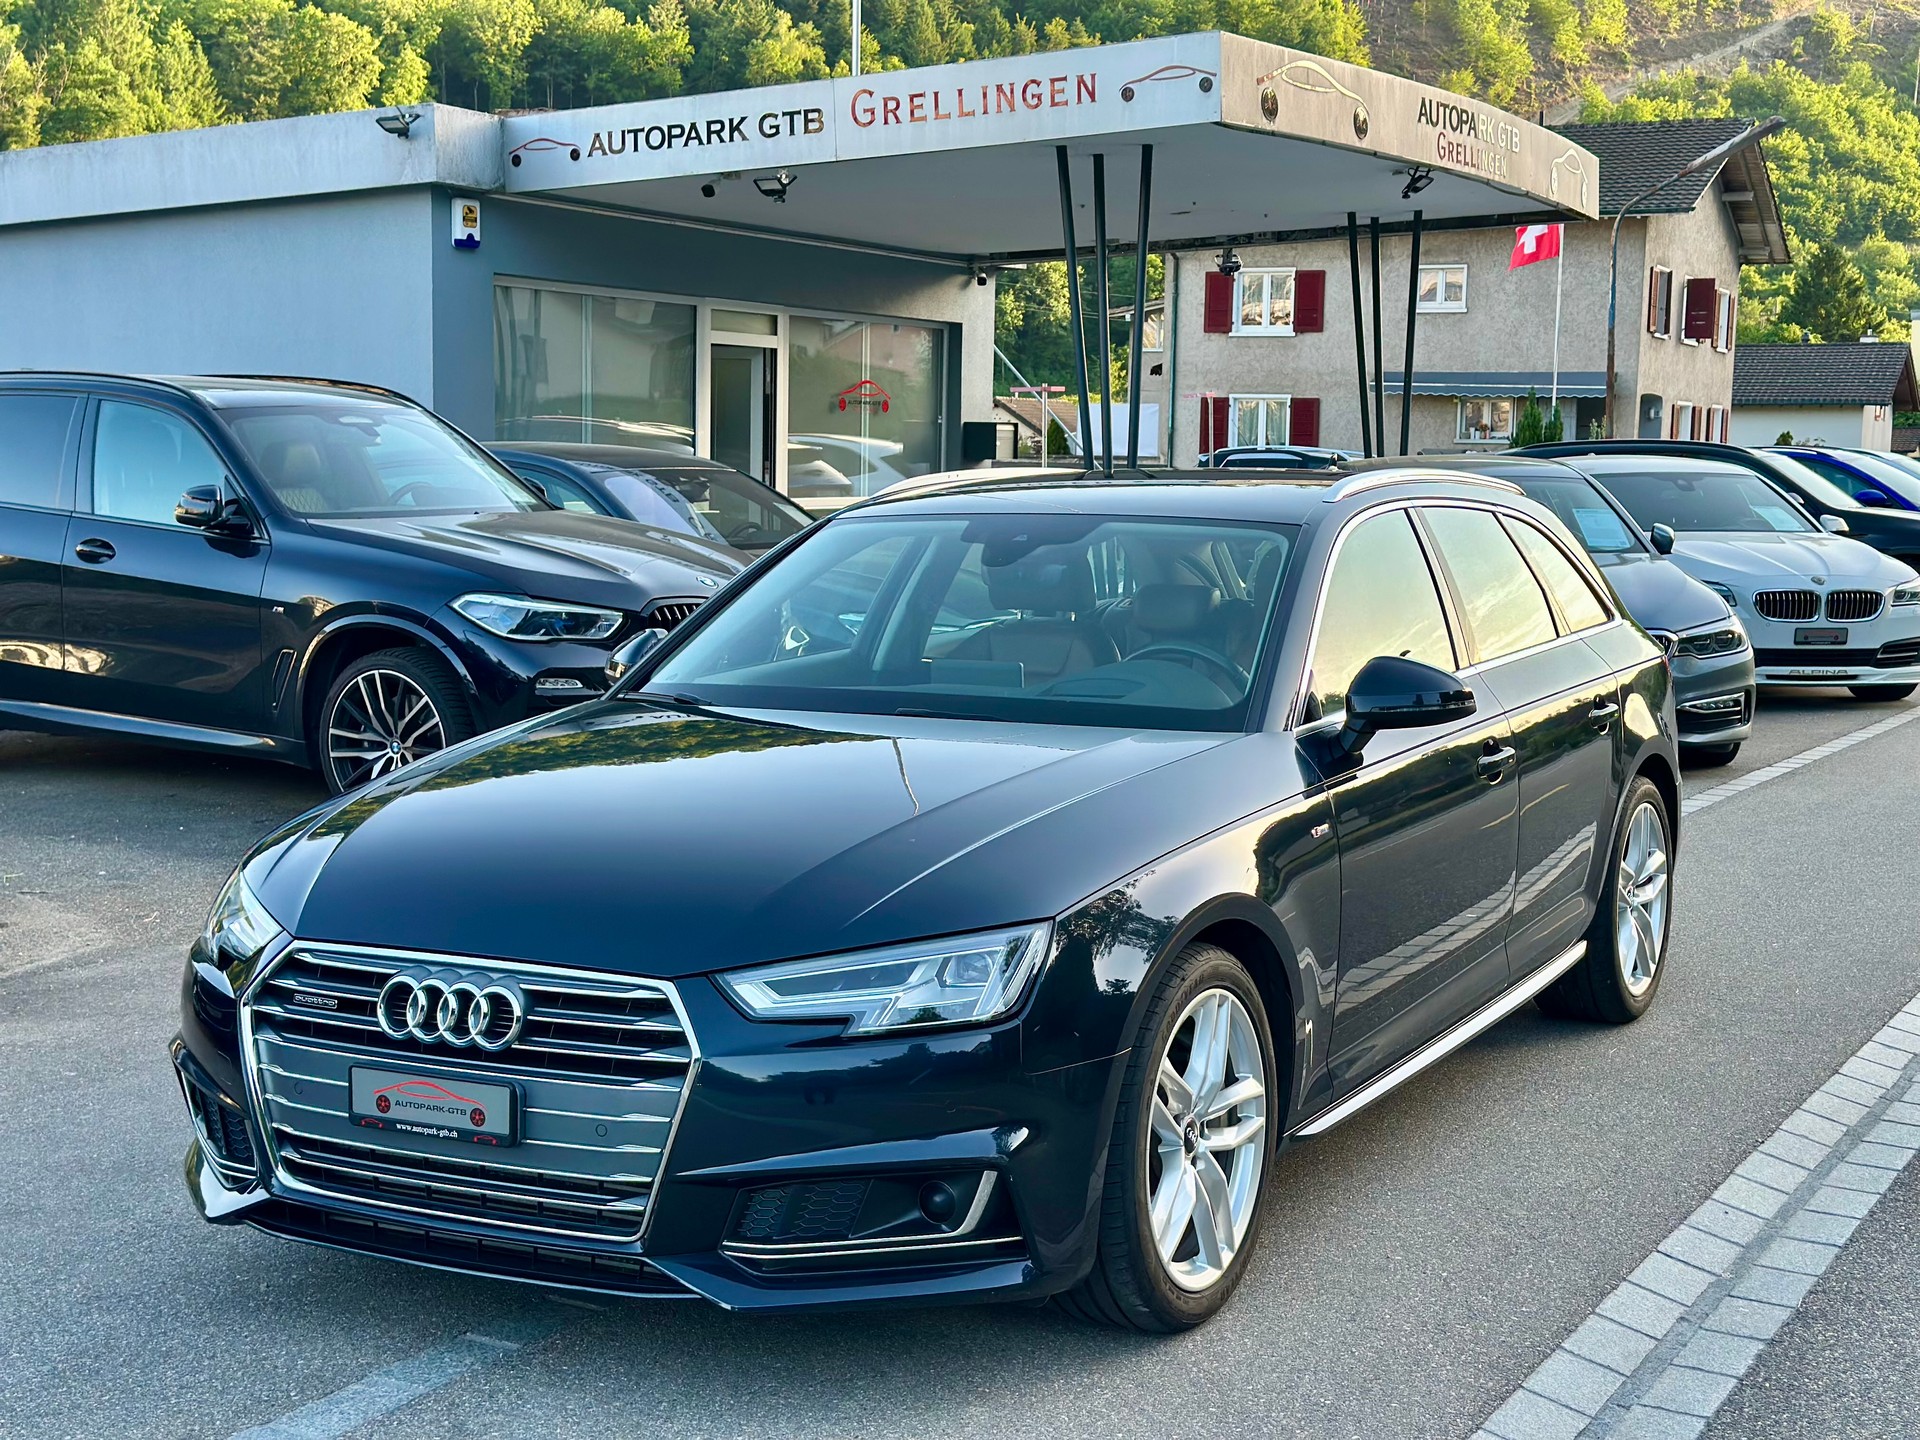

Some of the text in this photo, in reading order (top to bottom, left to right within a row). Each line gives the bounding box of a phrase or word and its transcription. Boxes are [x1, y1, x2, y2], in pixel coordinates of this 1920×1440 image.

[587, 116, 749, 157] AUTOPARK
[758, 108, 824, 138] GTB
[1418, 97, 1520, 153] AUTOPARK GTB
[394, 1100, 467, 1116] AUTOPARK-GTB
[396, 1122, 458, 1139] www.autopark-gtb.ch
